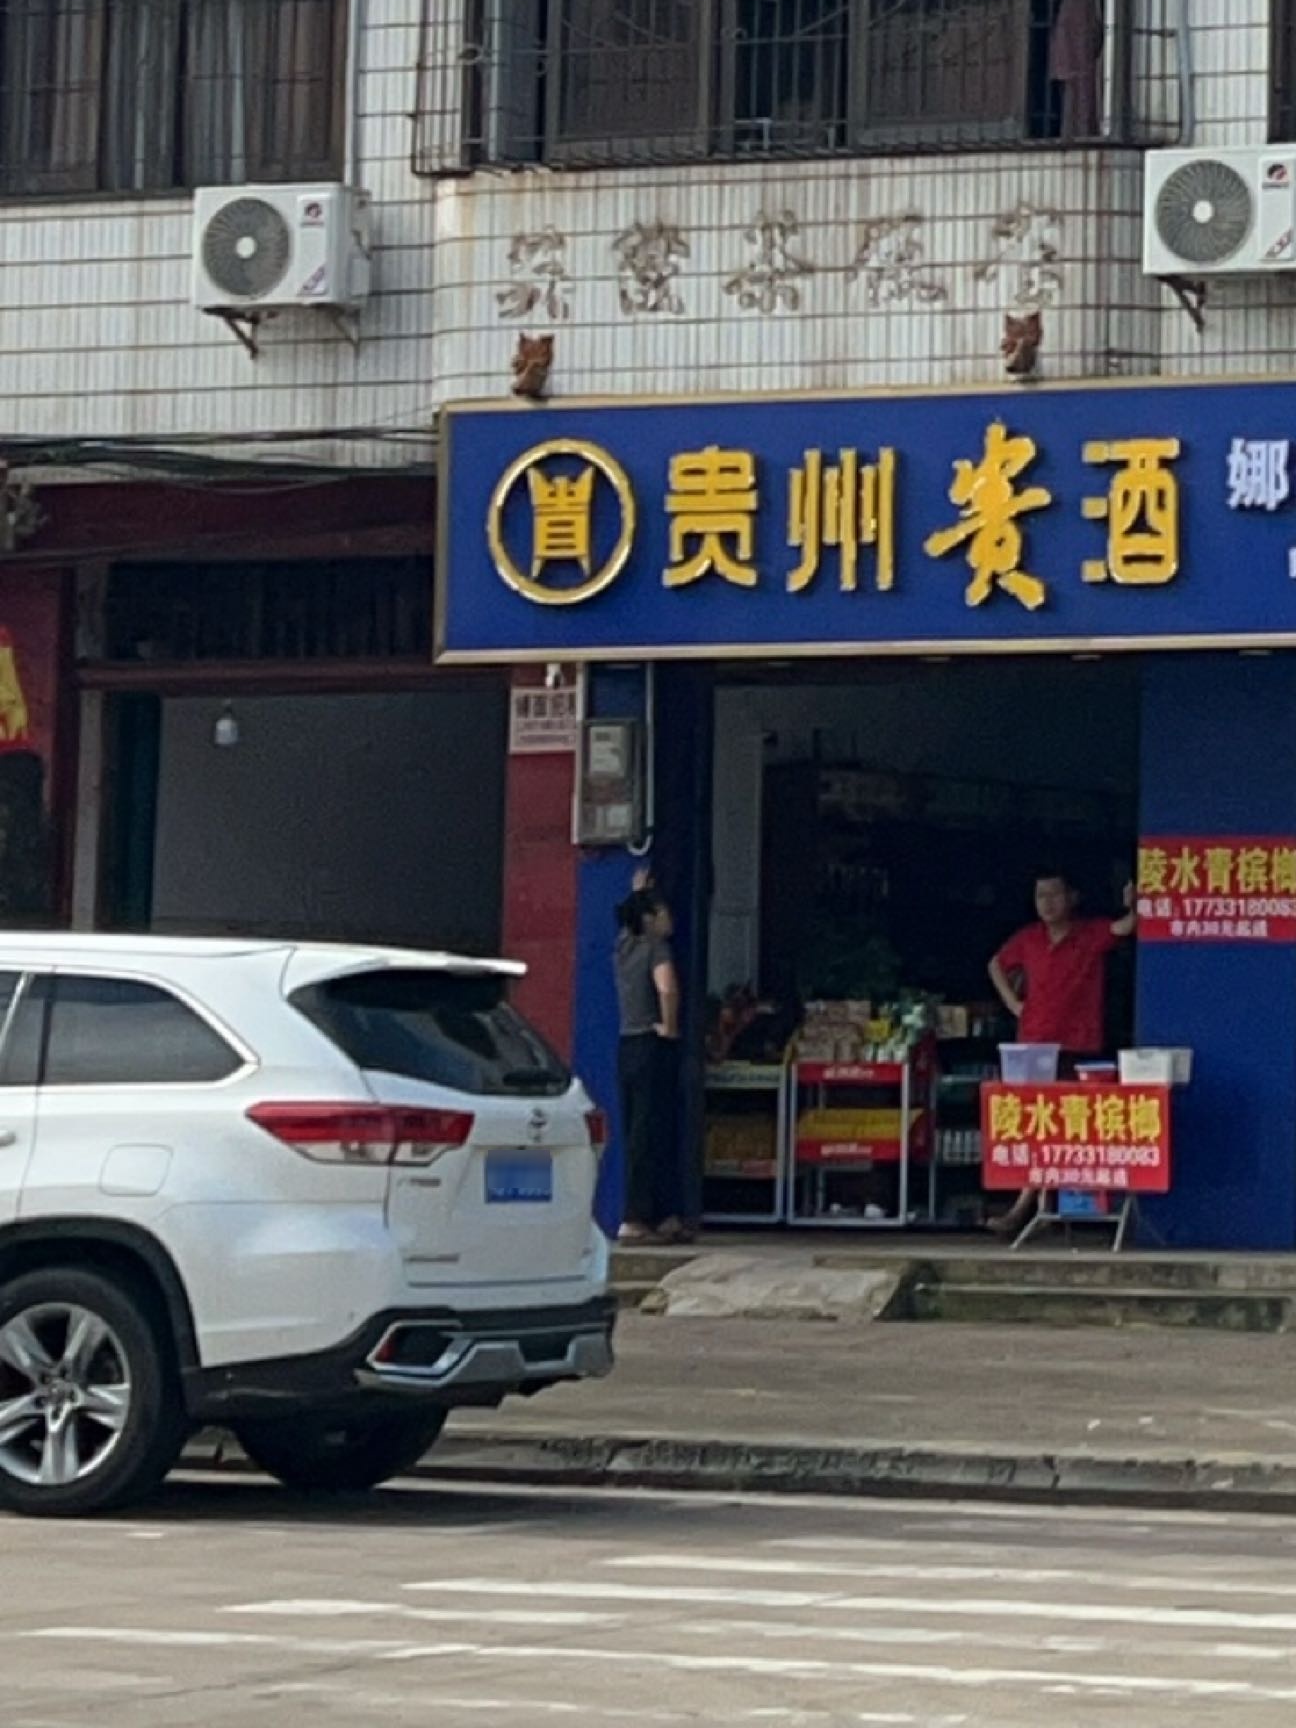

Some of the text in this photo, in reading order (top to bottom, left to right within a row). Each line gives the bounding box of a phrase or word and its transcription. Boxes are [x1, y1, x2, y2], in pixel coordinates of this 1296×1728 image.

[988, 1091, 1162, 1144] 陵水青槟榔
